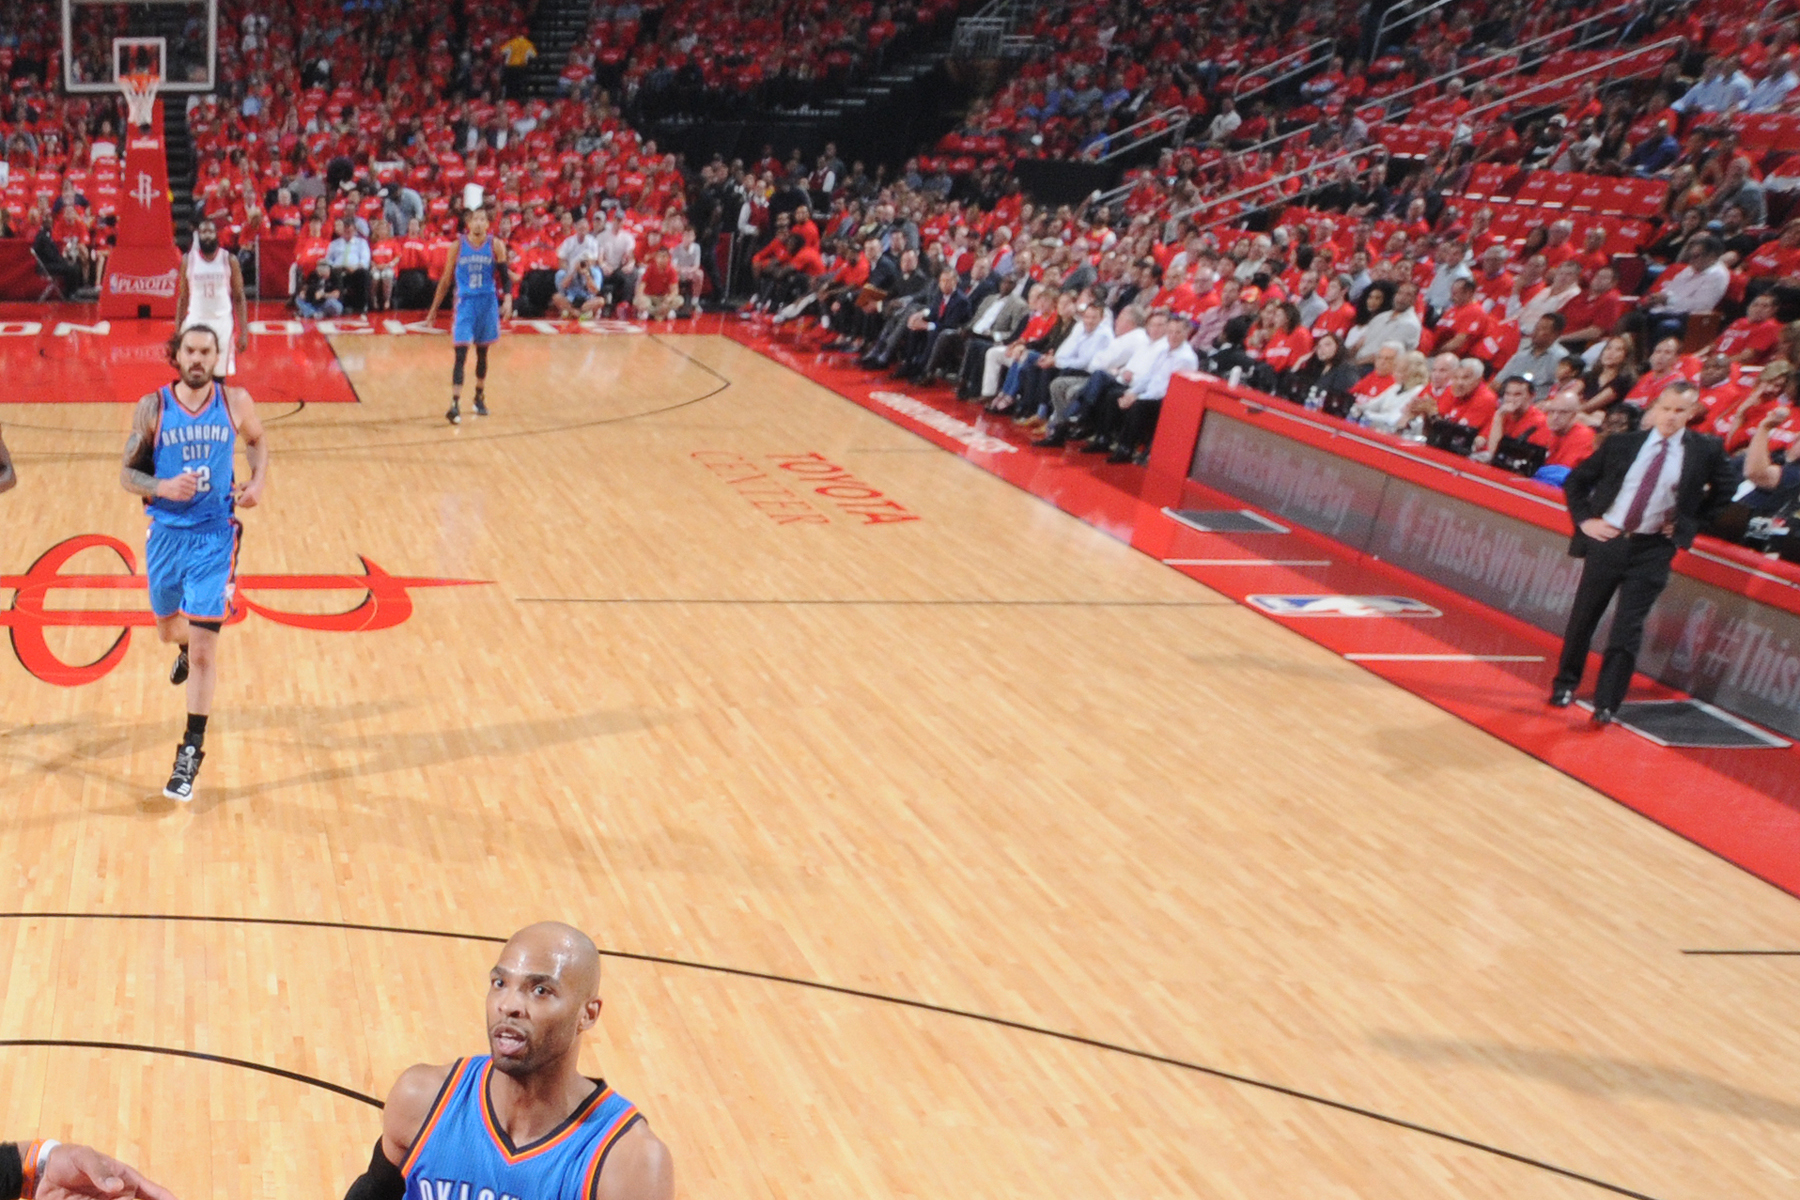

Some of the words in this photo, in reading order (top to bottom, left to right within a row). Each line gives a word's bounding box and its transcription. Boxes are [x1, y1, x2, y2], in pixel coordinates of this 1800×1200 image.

[469, 273, 483, 289] 21
[247, 319, 646, 334] OCKTS
[161, 423, 229, 447] OKLAHOMA
[182, 443, 211, 461] CITY
[690, 451, 831, 526] CENTER
[764, 451, 922, 526] TOYOTA
